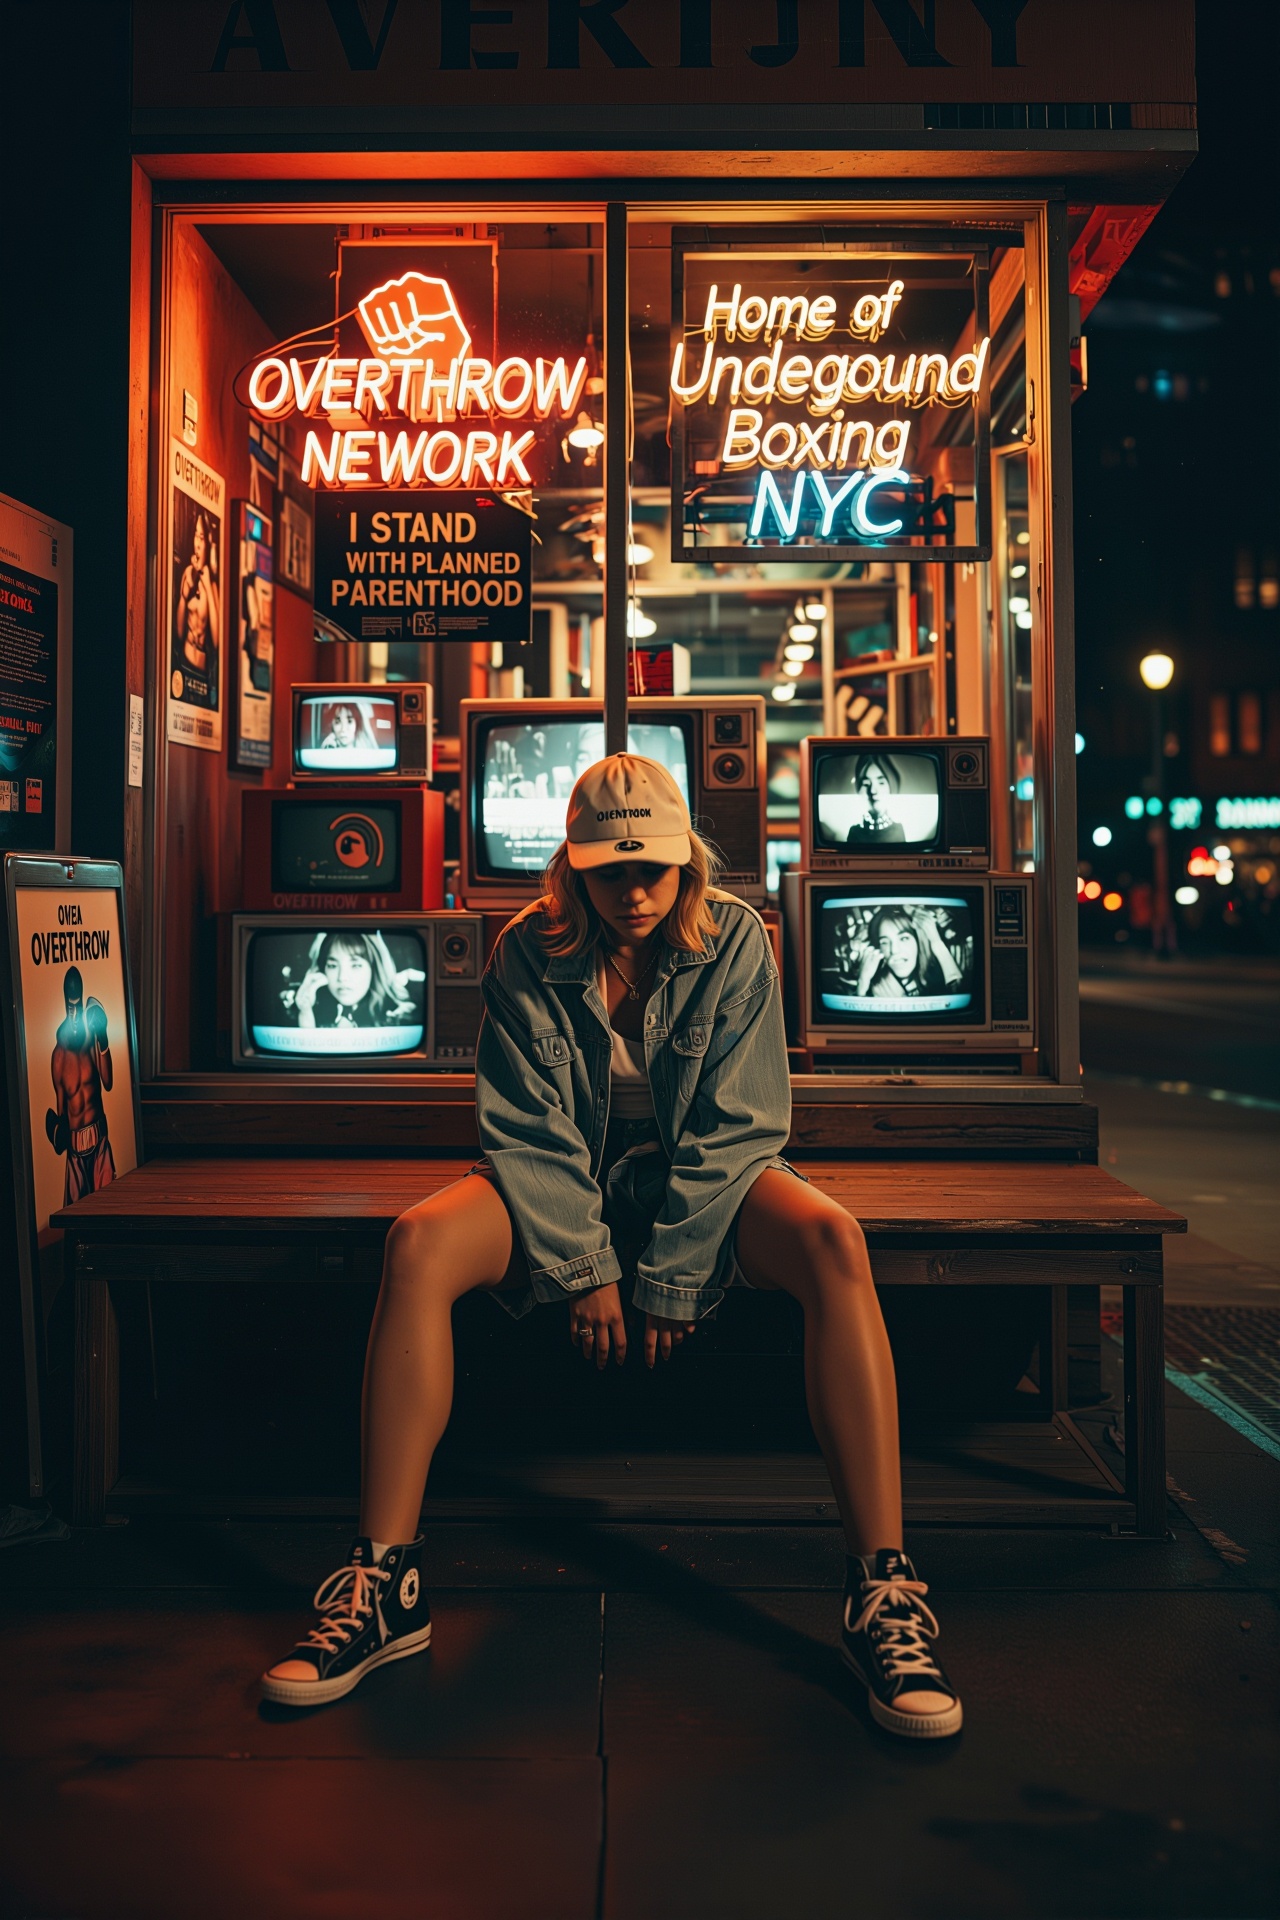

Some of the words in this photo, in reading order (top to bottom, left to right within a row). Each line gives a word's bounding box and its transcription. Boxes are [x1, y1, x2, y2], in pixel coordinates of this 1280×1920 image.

[704, 283, 837, 332] Home
[851, 279, 905, 329] of
[248, 356, 587, 412] OVERTHROW
[670, 336, 991, 407] Undegound
[300, 429, 535, 484] NEWORK
[721, 408, 912, 476] Boxing
[349, 512, 358, 544] I
[370, 511, 477, 544] STAND
[750, 470, 911, 538] NYC
[346, 551, 406, 574] WITH
[412, 551, 521, 575] PLANNED
[331, 579, 524, 607] PARENTHOOD
[31, 930, 110, 966] OVERTHROW
